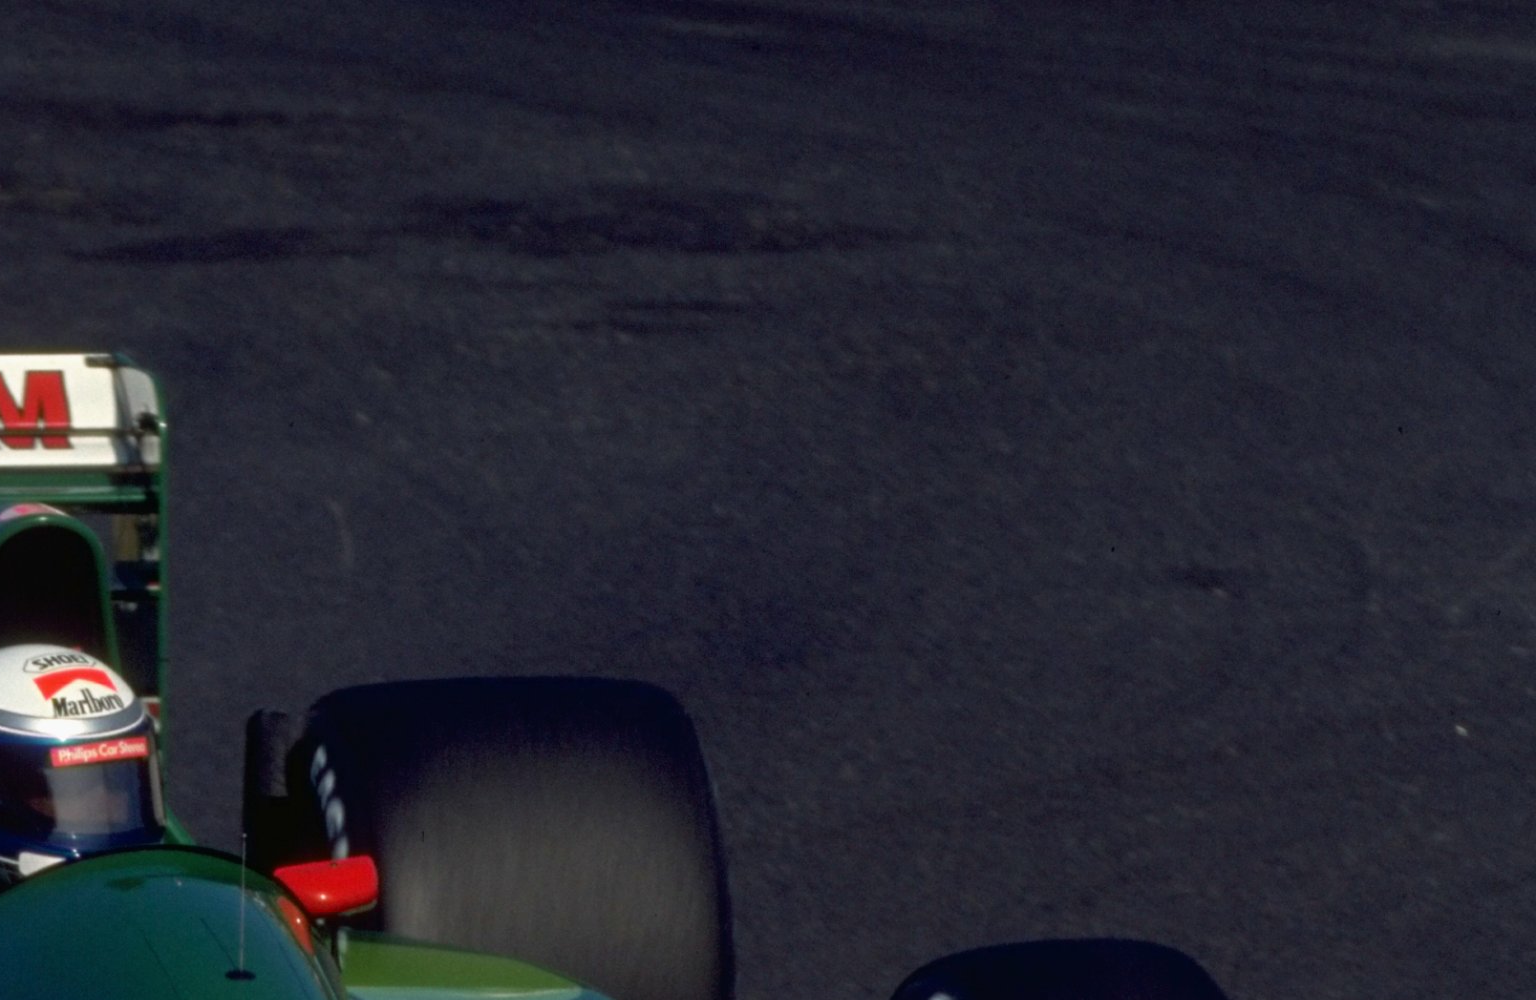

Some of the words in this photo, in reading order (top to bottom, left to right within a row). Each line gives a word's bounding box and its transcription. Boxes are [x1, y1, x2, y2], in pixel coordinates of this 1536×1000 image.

[32, 652, 90, 671] SHOEI
[52, 688, 124, 719] Marlboro
[58, 745, 98, 763] Philips
[98, 743, 118, 757] Car
